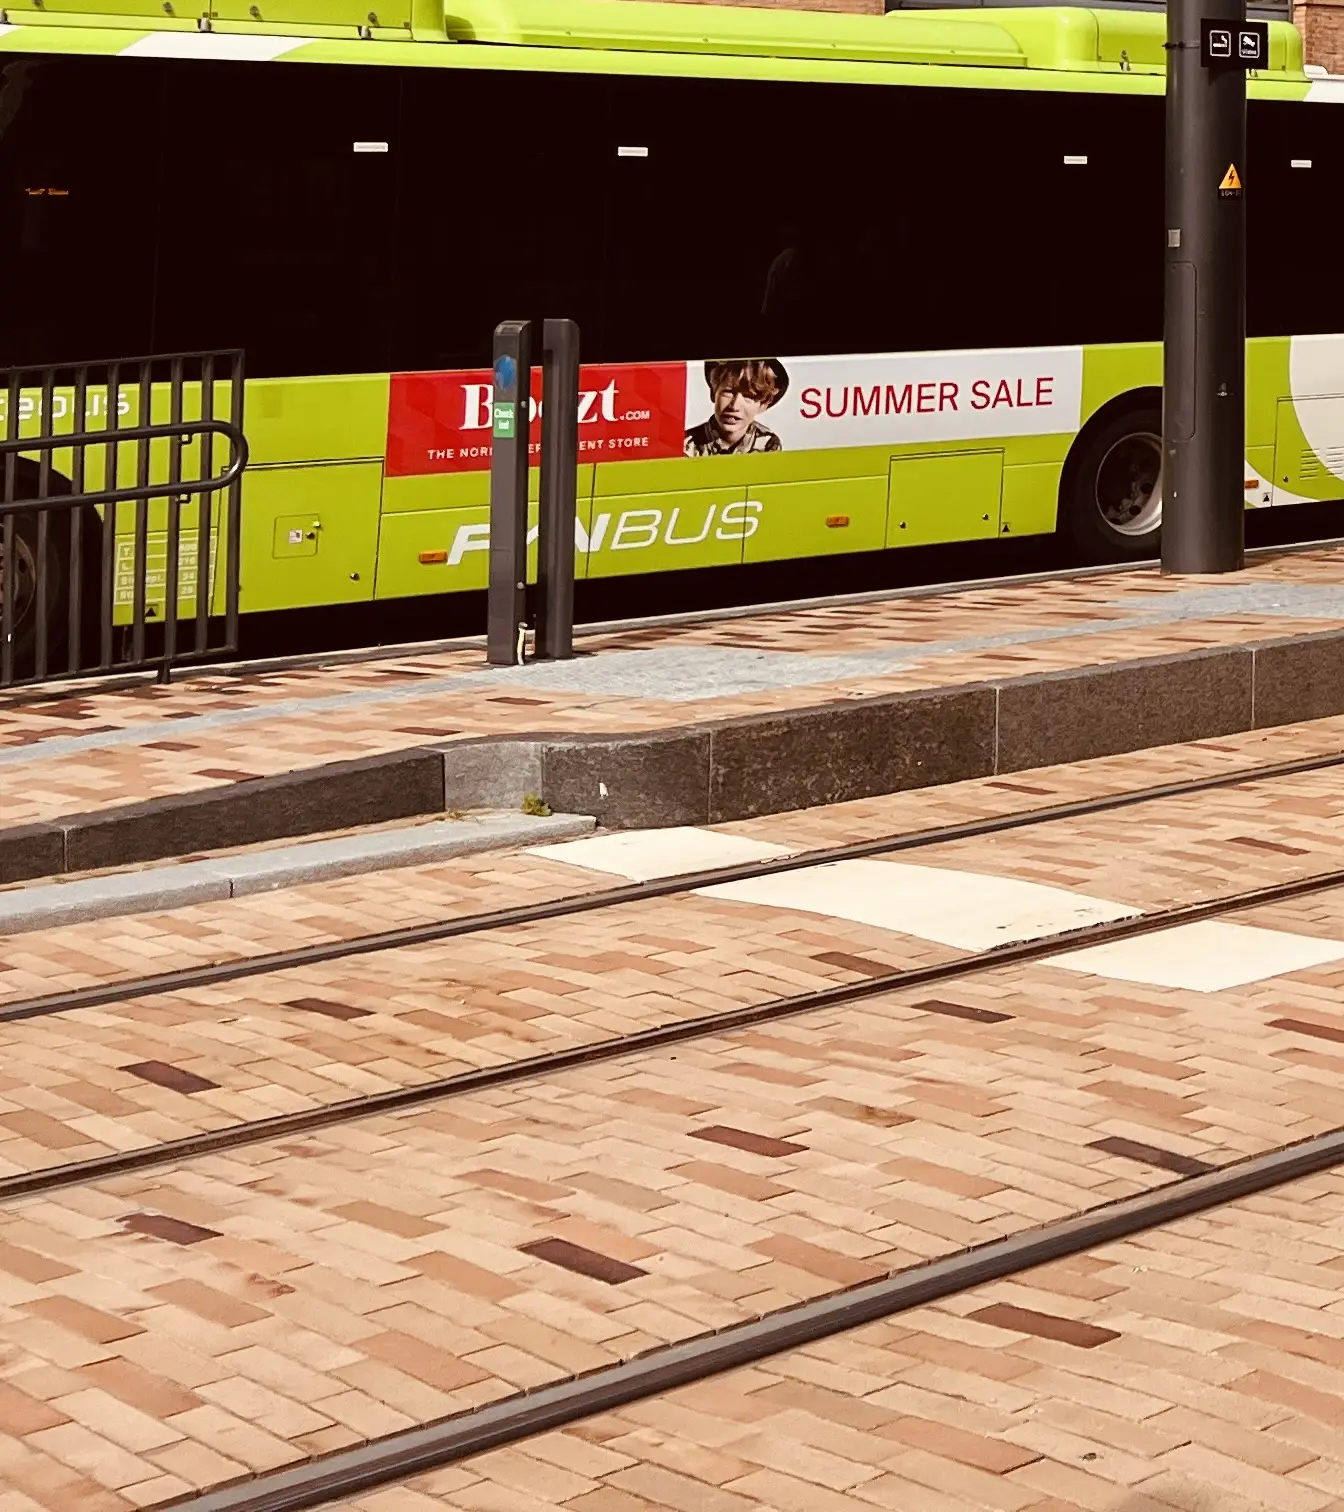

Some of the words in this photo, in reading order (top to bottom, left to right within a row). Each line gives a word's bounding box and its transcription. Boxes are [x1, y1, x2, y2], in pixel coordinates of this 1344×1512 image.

[800, 382, 959, 419] SUMMER
[970, 377, 1055, 410] SALE
[427, 449, 454, 459] THE
[608, 436, 649, 449] STORE
